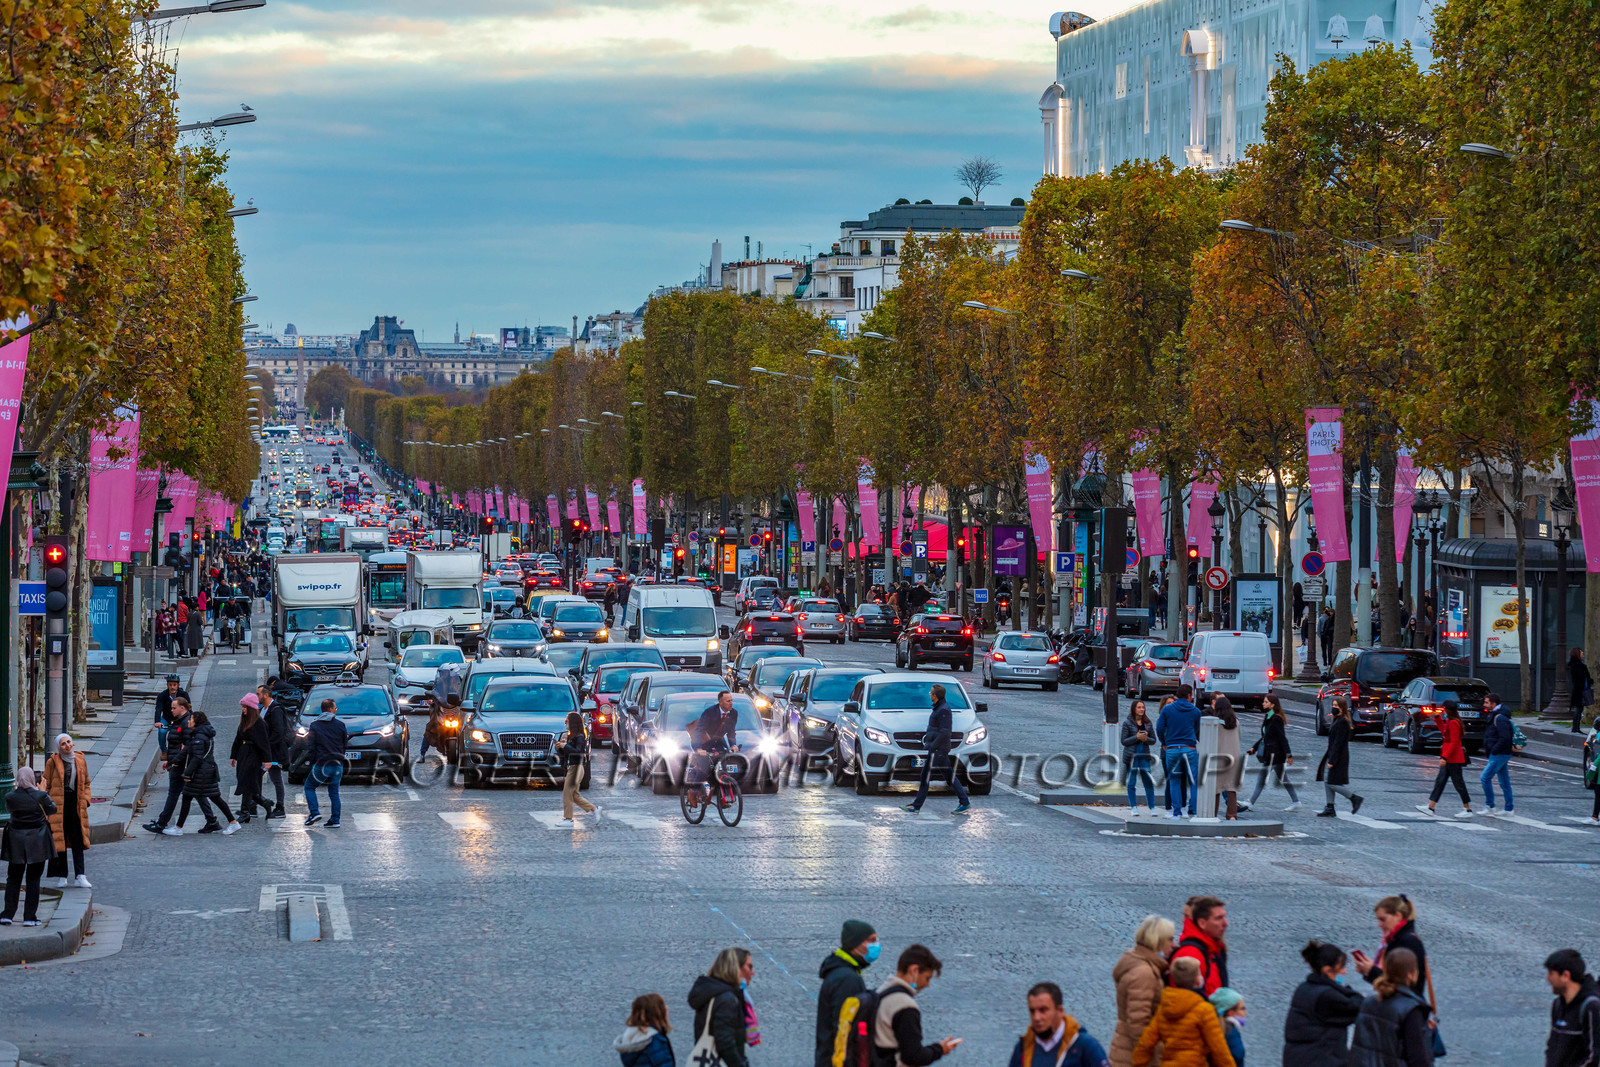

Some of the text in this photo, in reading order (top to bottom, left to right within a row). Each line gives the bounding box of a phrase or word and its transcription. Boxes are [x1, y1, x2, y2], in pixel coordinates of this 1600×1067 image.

[1310, 439, 1338, 447] PHOTO
[916, 546, 926, 557] P
[1061, 557, 1071, 569] P
[297, 583, 342, 591] swipop.fr
[20, 594, 46, 604] TAXIS
